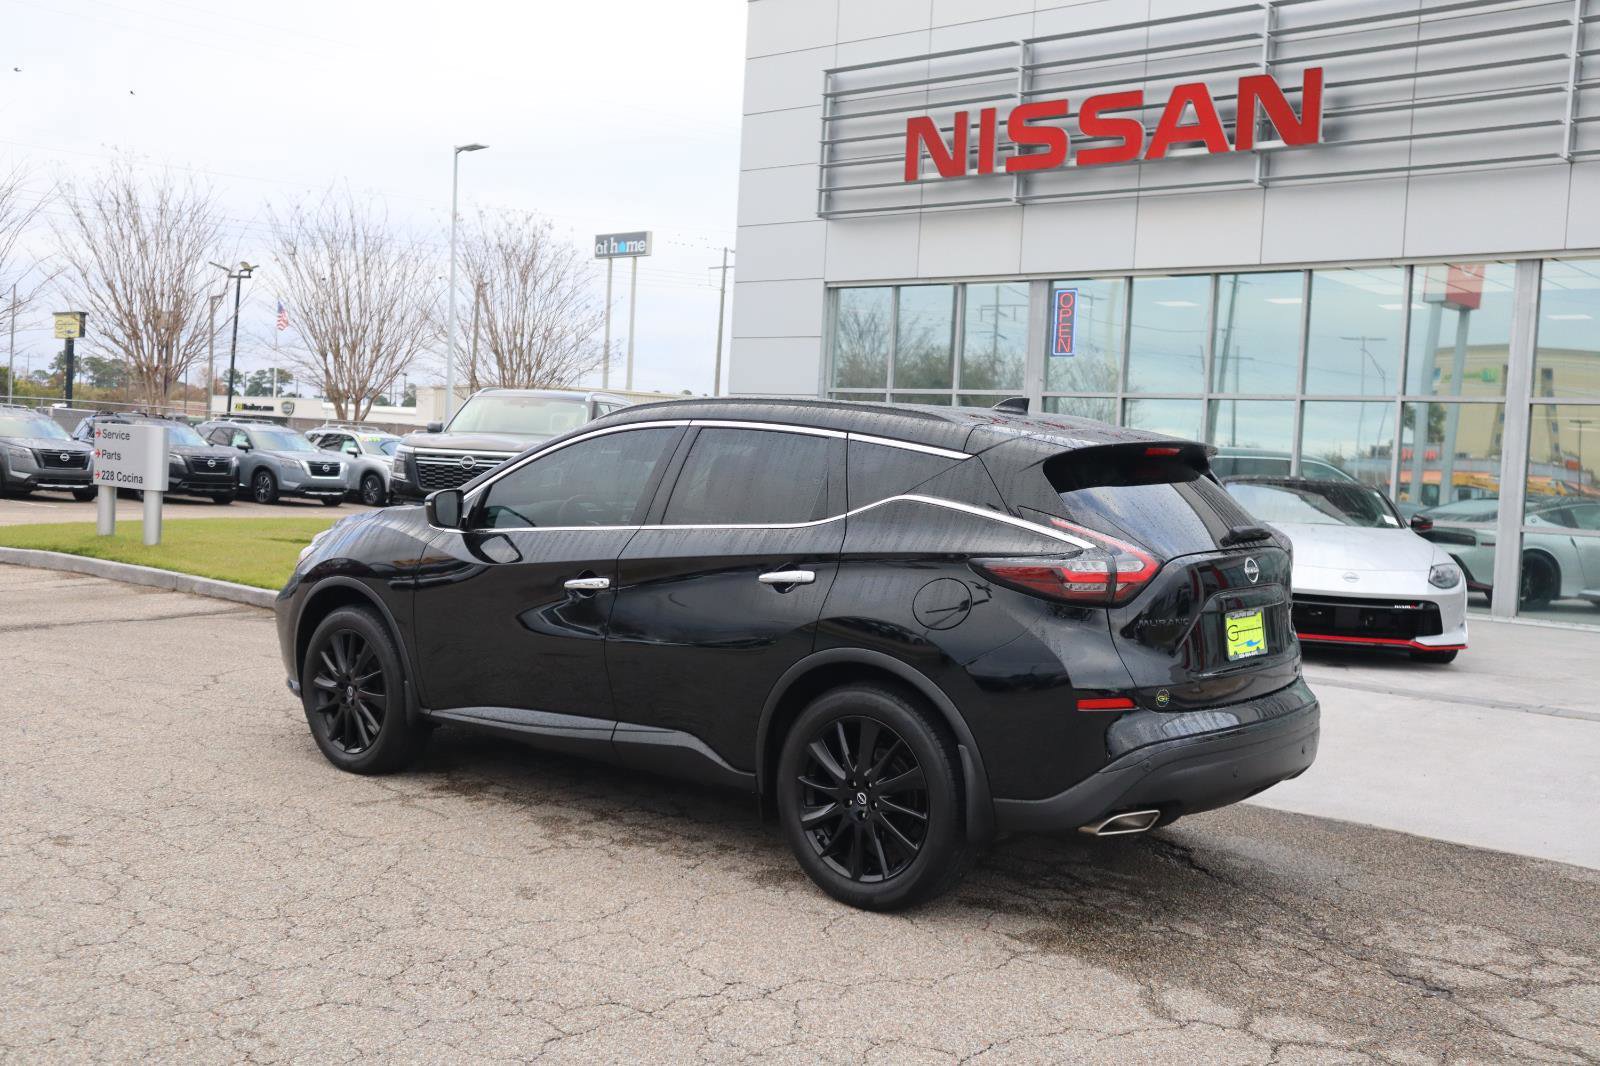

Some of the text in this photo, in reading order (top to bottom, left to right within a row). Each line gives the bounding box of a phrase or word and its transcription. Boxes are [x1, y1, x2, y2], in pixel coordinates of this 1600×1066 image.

[904, 67, 1324, 183] NISSAN
[595, 237, 646, 254] at home
[1057, 293, 1075, 353] OPEN
[102, 428, 131, 440] Service
[101, 449, 122, 460] Parts
[101, 470, 143, 484] 228 Cocina
